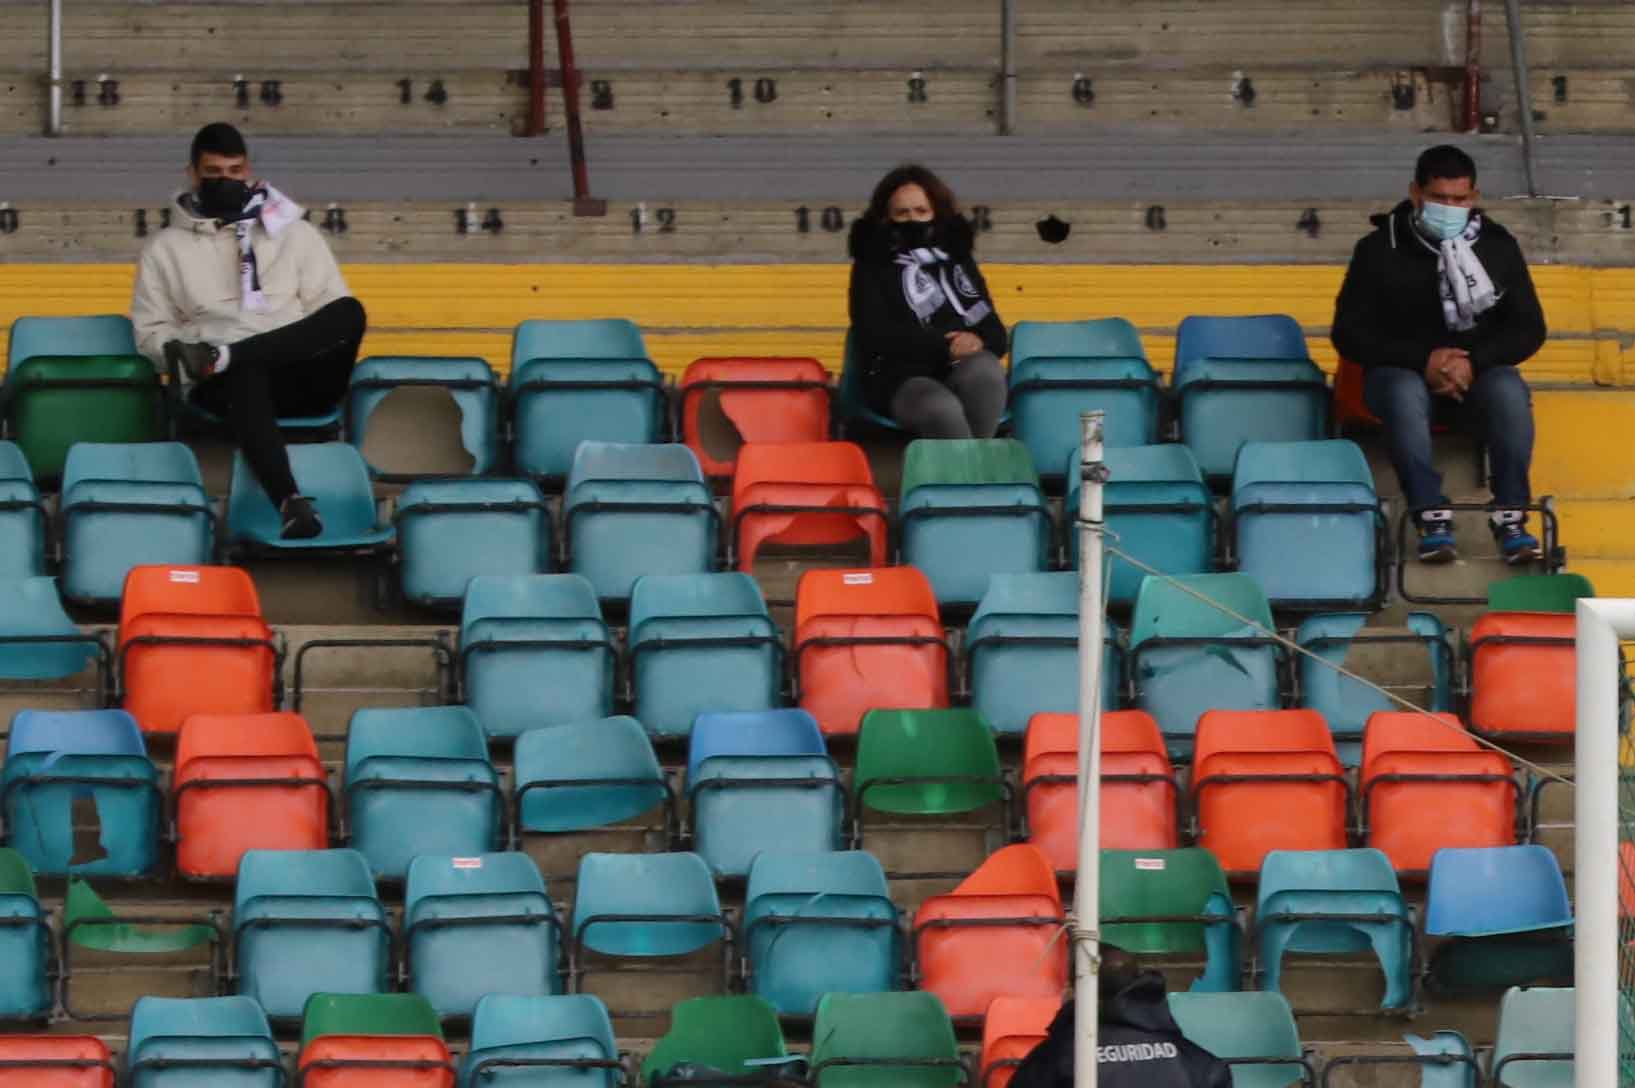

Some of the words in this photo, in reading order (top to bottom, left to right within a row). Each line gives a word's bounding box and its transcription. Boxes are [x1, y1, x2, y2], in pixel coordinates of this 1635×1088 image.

[396, 78, 448, 106] 14
[725, 77, 775, 110] 10
[1550, 76, 1567, 104] 1
[796, 205, 844, 233] 10
[1097, 1042, 1177, 1063] EGURIDAD
